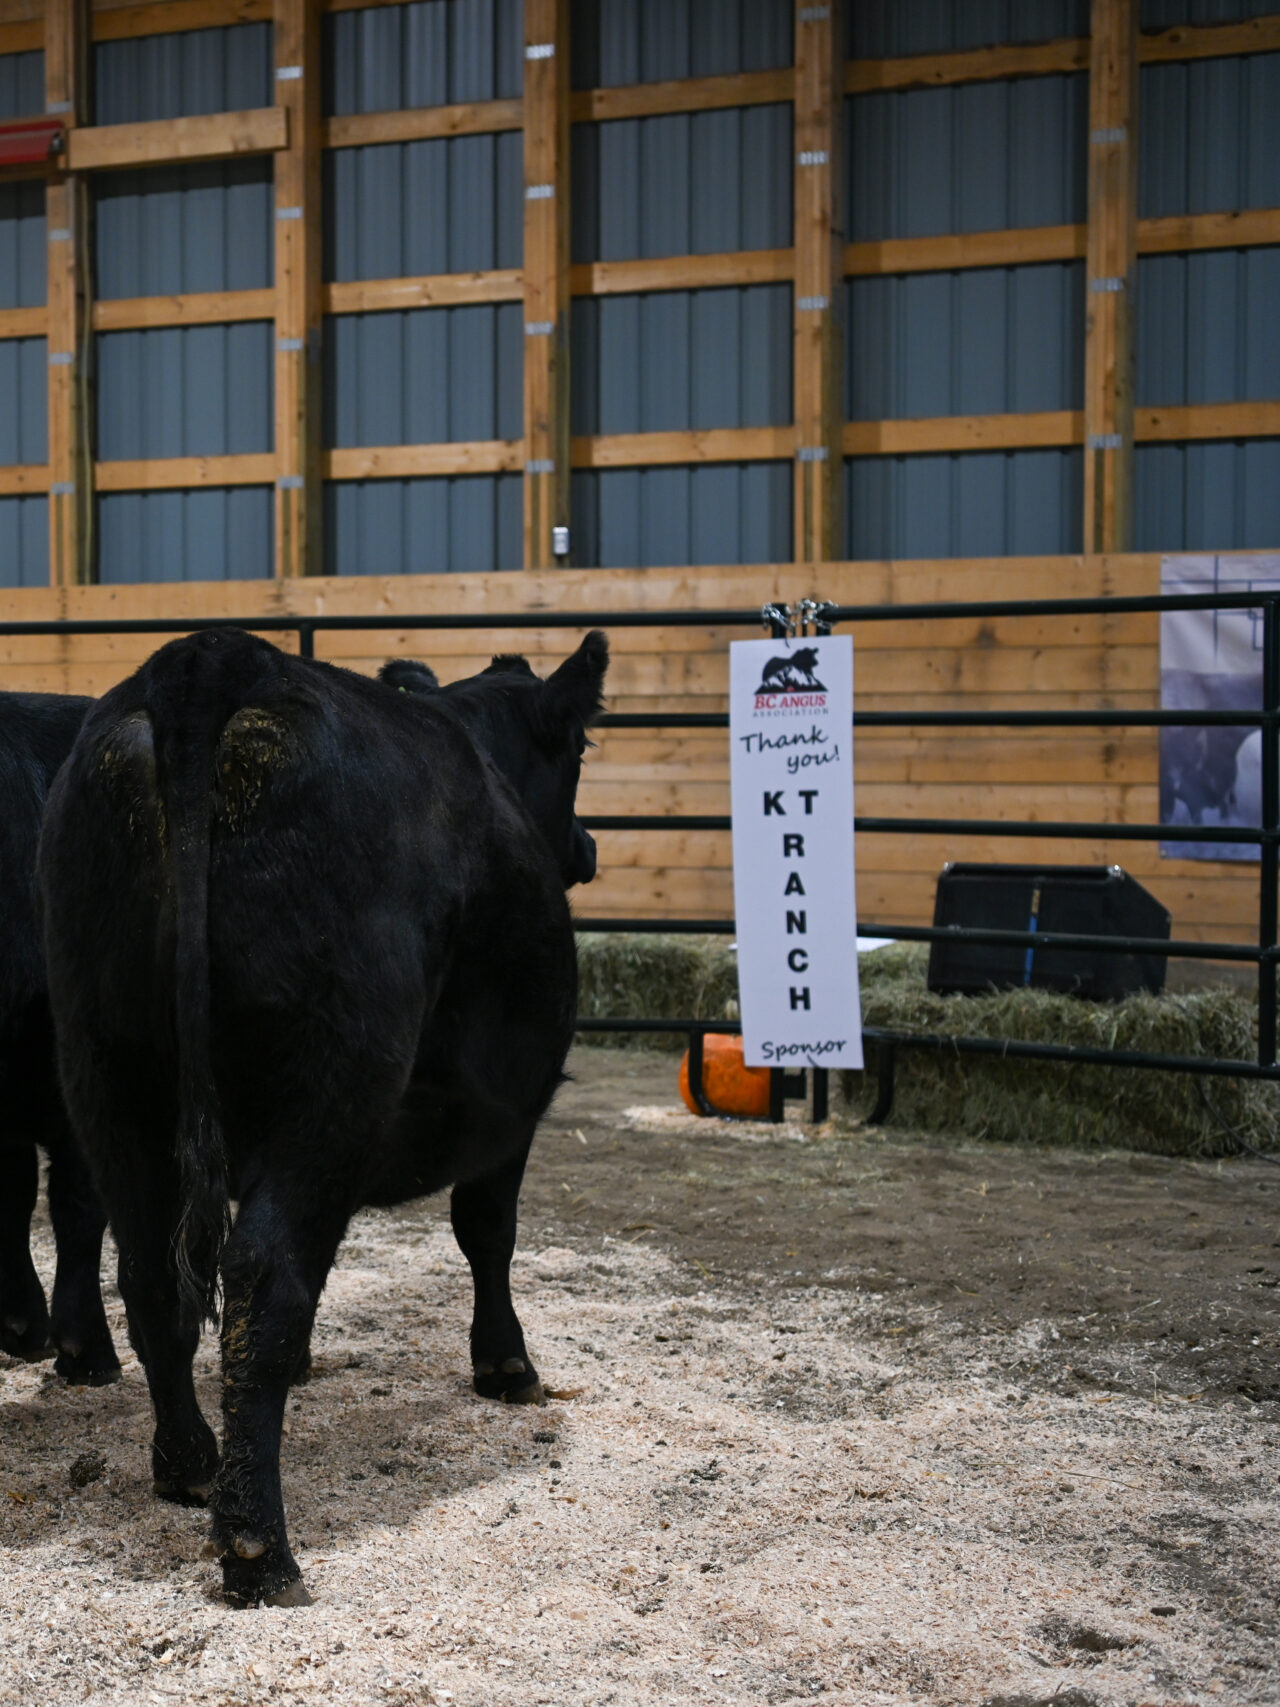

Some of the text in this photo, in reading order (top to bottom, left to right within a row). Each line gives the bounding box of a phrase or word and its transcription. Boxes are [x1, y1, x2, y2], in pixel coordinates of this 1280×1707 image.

[780, 694, 826, 708] ANGUS
[753, 707, 829, 718] ASSOCIATION
[739, 724, 828, 753] Thank
[787, 743, 840, 775] you!
[761, 1040, 847, 1062] Sponsor
